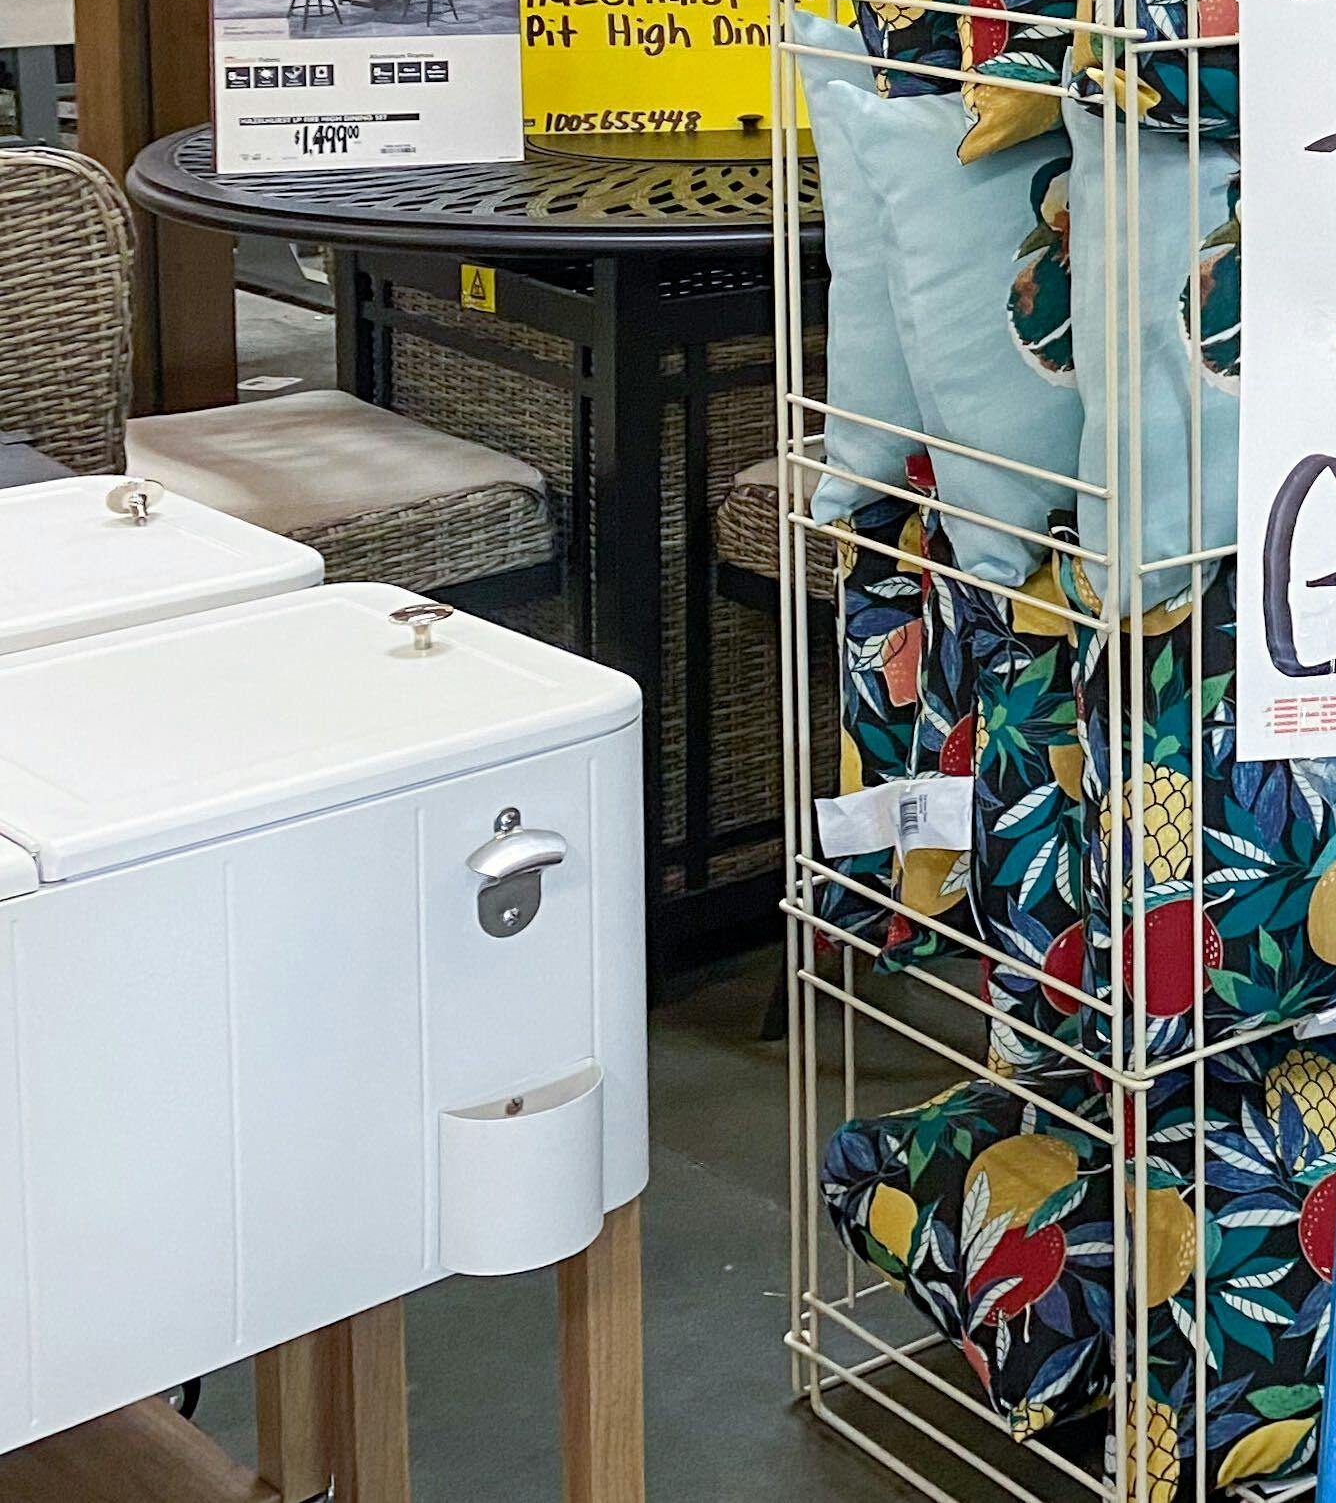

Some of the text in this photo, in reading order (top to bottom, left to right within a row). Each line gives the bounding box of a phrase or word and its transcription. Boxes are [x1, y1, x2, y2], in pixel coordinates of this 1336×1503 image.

[526, 13, 578, 48] Pit
[607, 12, 693, 55] High
[544, 110, 703, 134] 1005655448
